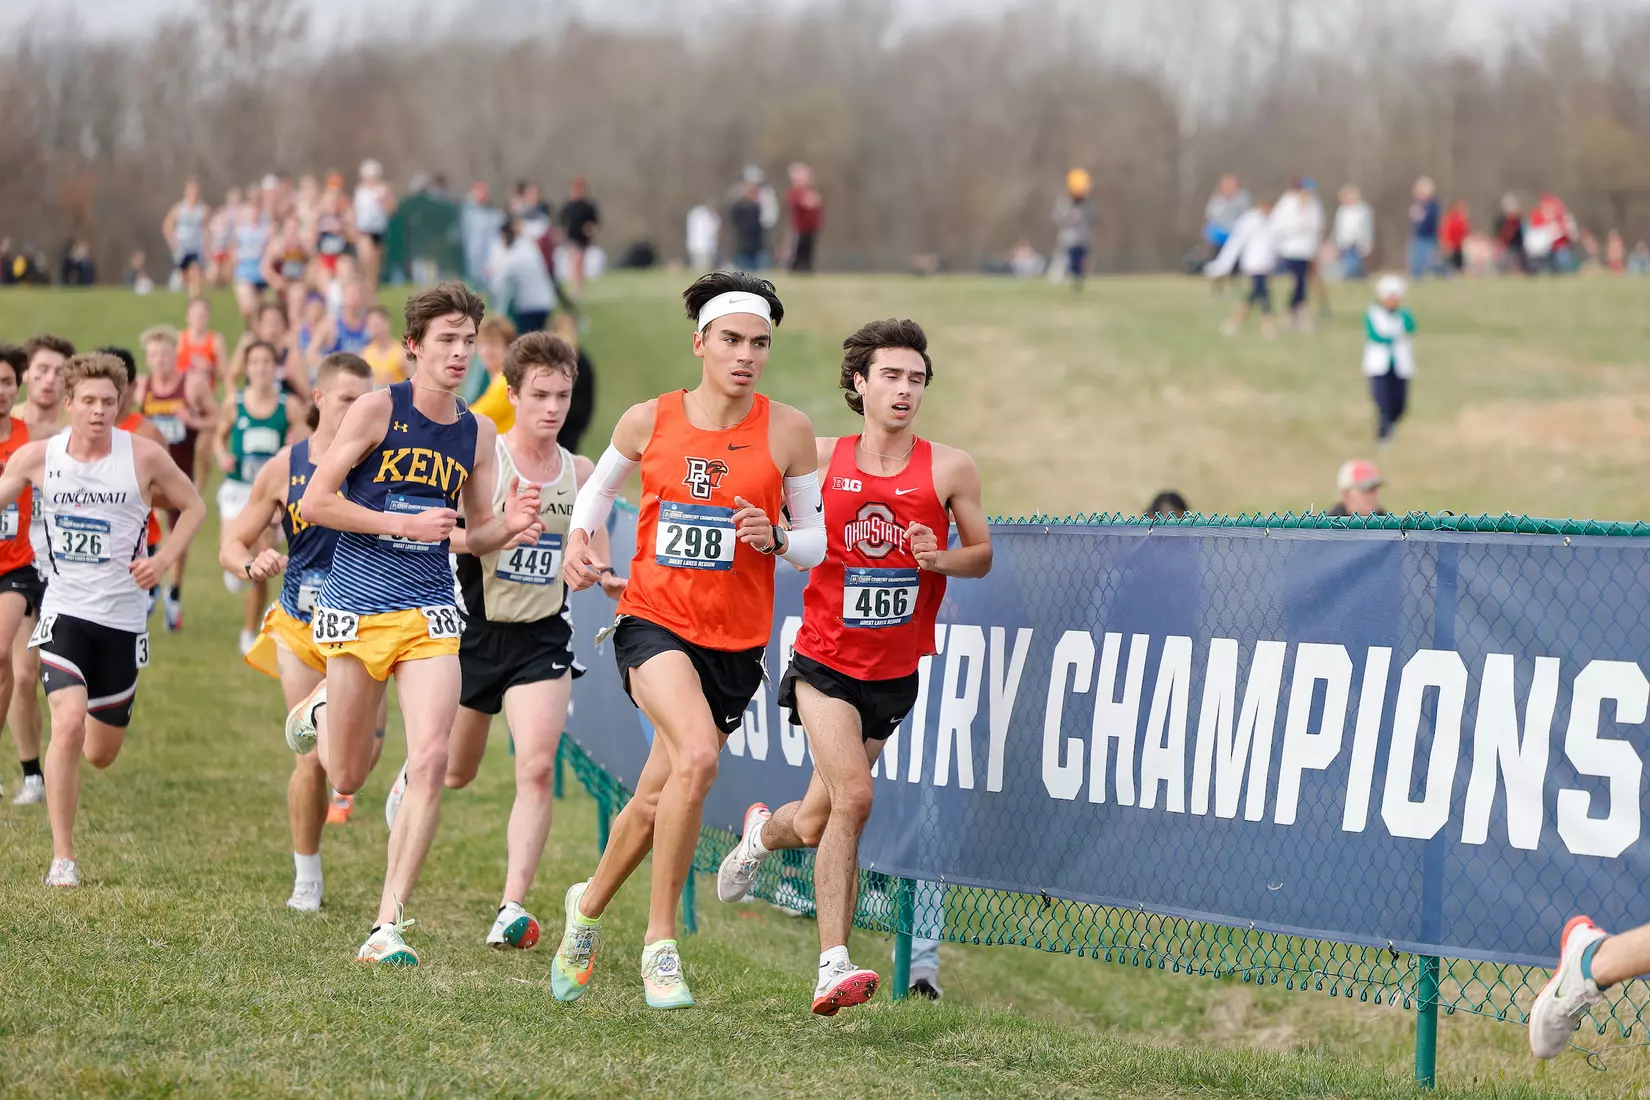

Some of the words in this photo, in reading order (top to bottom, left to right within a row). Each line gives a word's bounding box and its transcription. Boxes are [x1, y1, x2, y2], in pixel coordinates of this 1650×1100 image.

[373, 447, 469, 500] KENT
[53, 491, 127, 504] CINCINNATI
[62, 531, 102, 555] 326
[665, 525, 722, 559] 298
[509, 548, 552, 575] 449
[855, 588, 908, 617] 466
[315, 609, 355, 639] 382
[1042, 630, 1650, 858] CHAMPIONS
